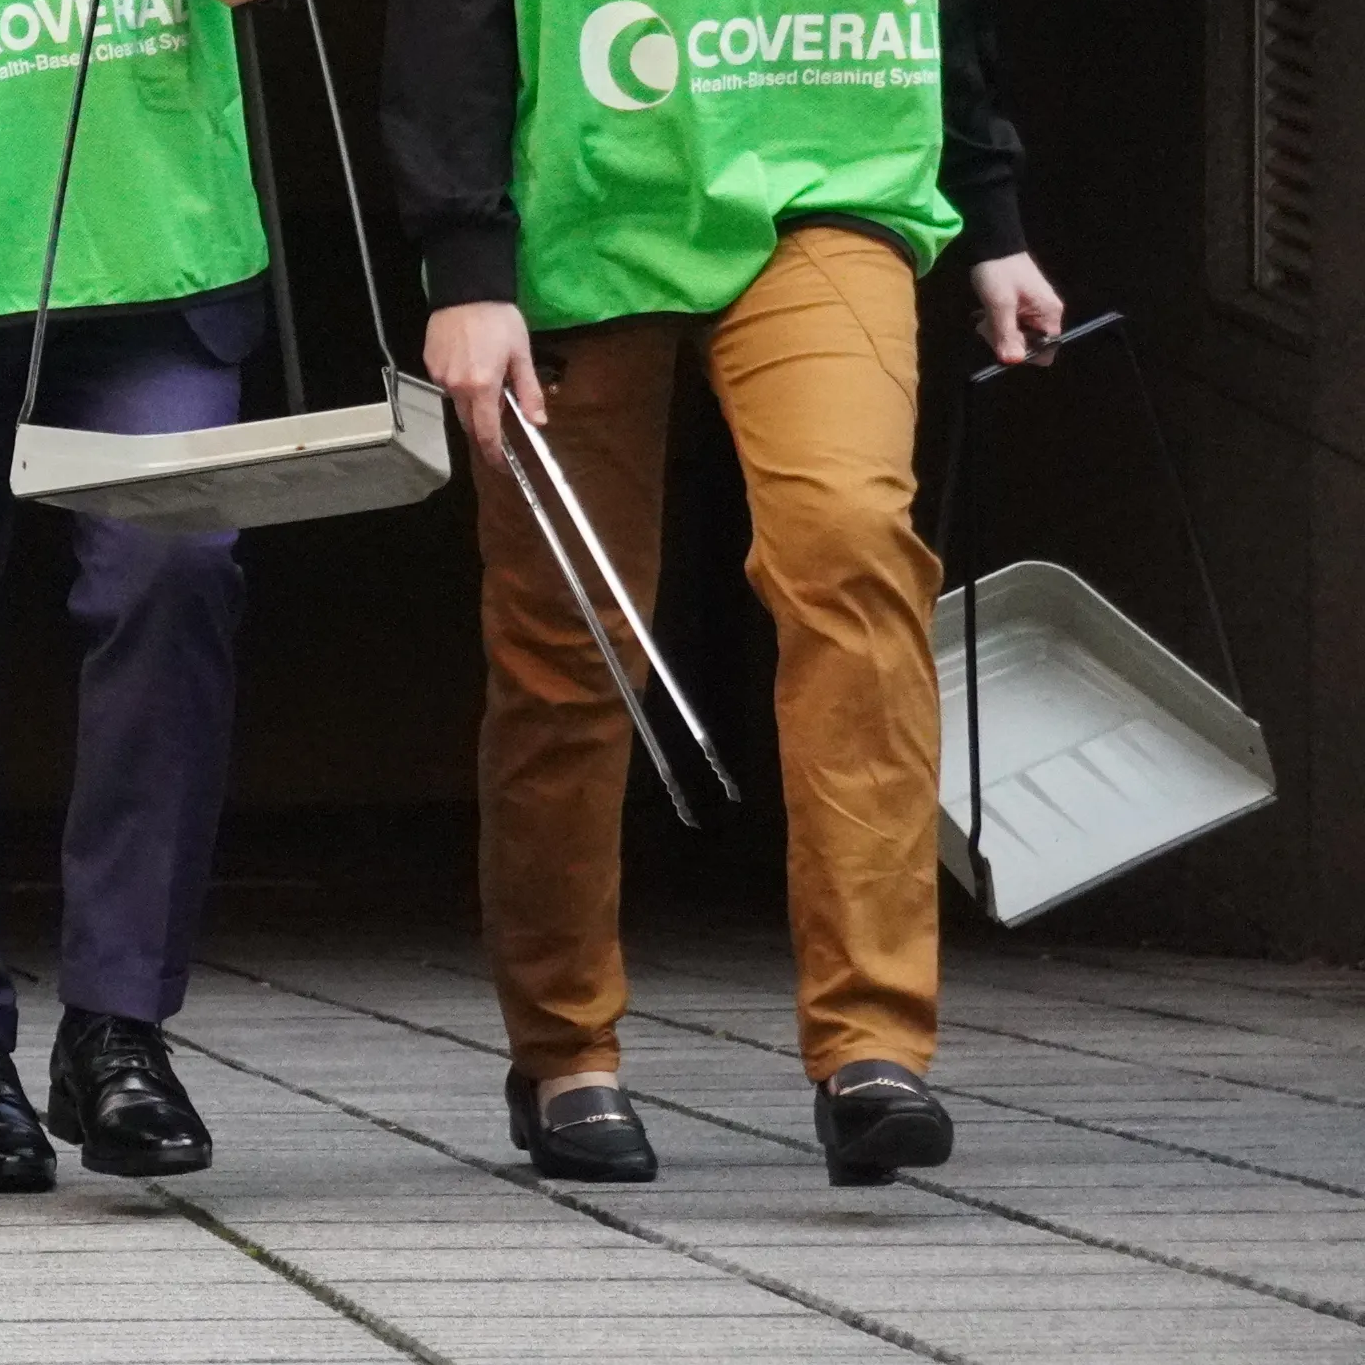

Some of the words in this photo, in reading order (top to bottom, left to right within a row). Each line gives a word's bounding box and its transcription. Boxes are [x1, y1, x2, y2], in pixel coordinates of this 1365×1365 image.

[687, 12, 941, 68] COVERAL
[690, 68, 798, 94] Health-Based
[801, 68, 886, 88] Cleaning
